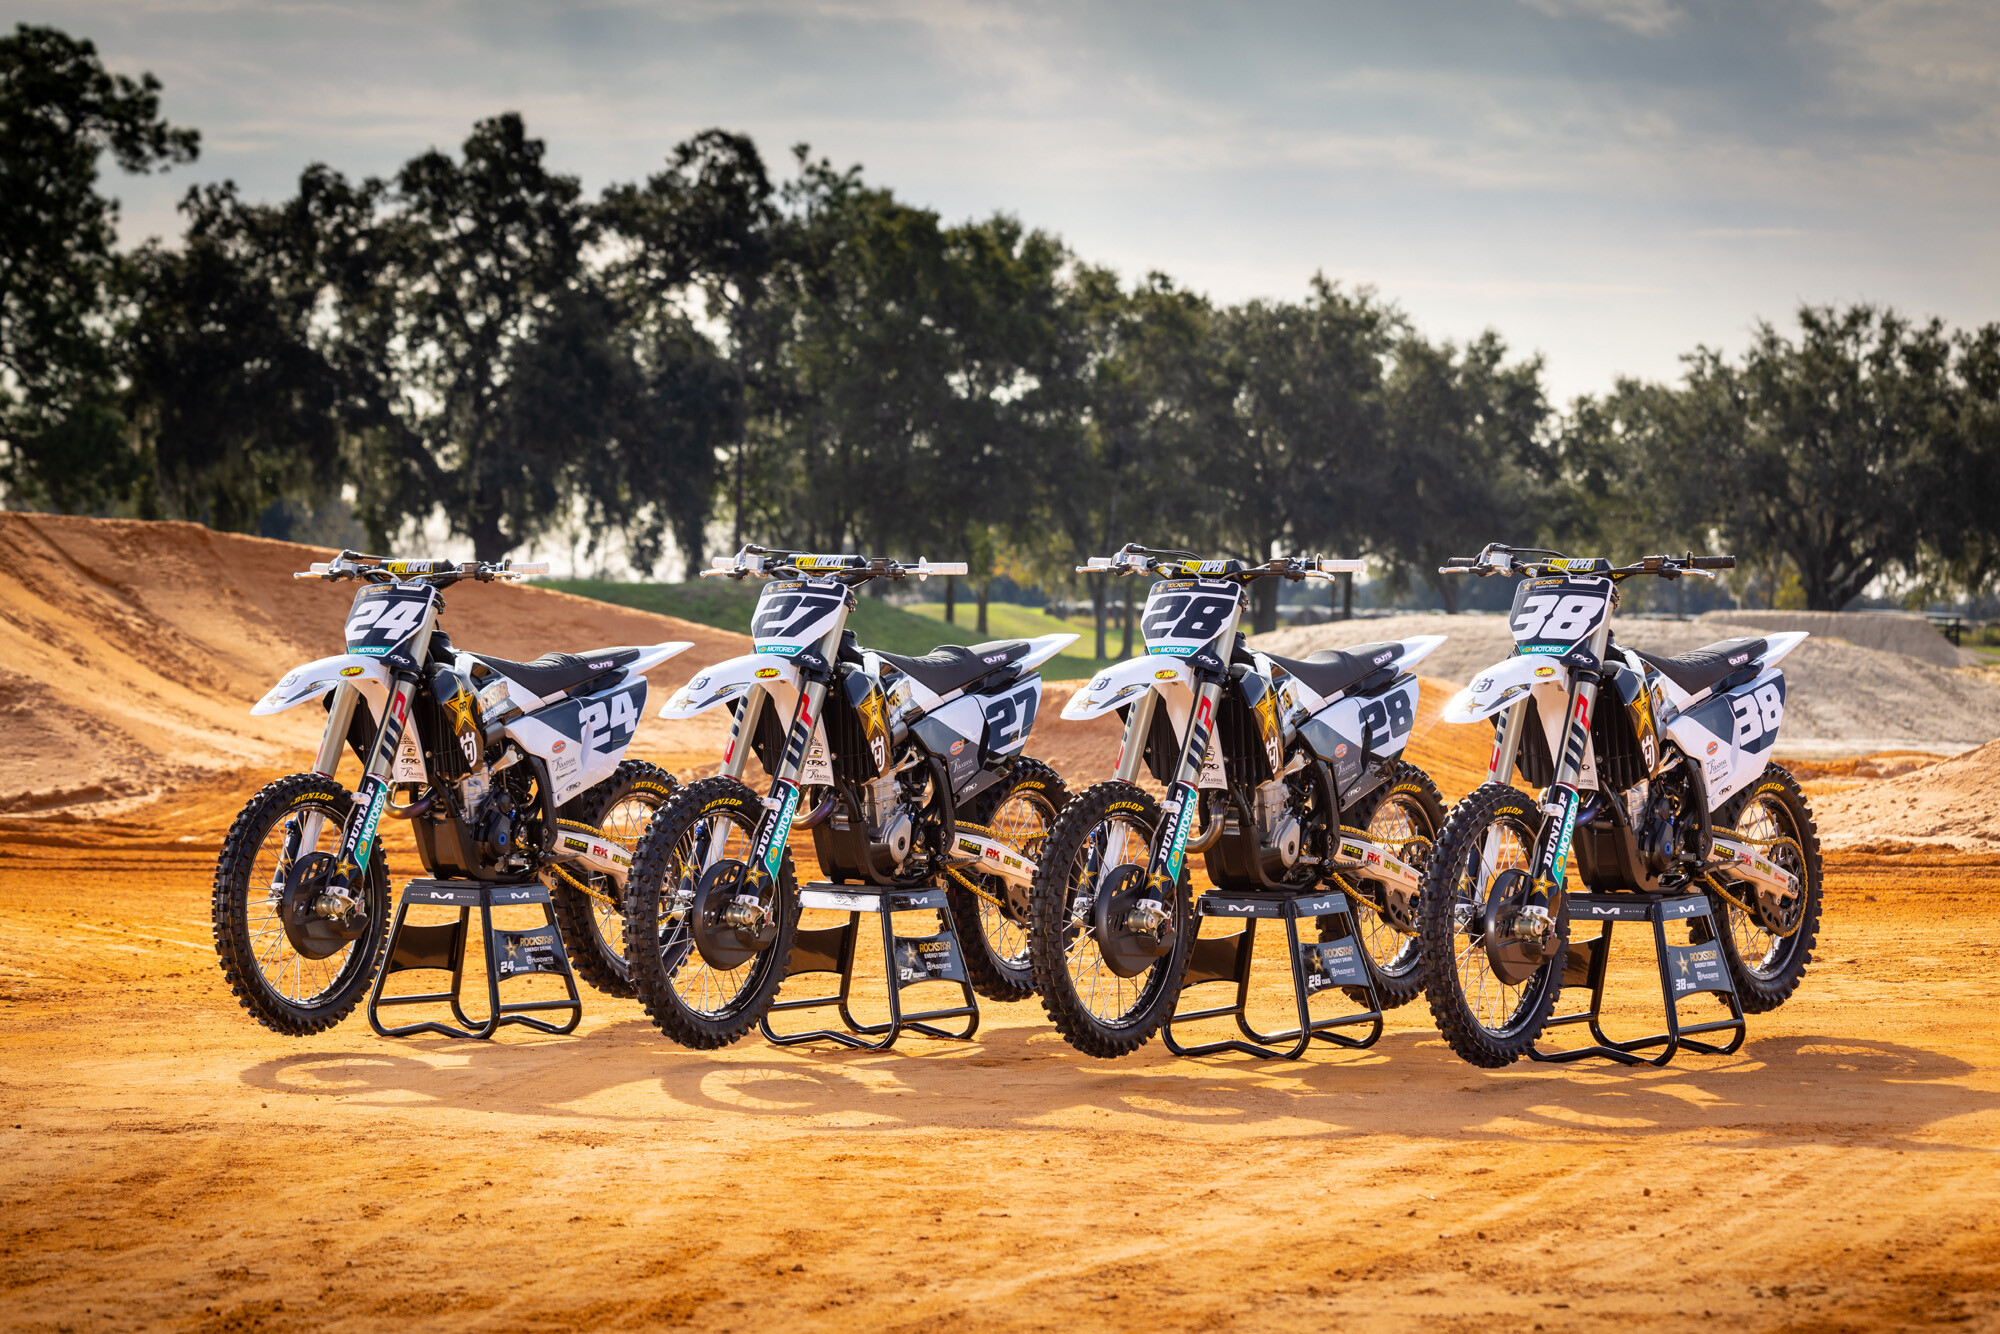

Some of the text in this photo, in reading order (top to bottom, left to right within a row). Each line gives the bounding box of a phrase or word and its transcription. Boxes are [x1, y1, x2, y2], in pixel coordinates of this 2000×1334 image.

[345, 601, 426, 641] 24
[753, 595, 841, 638] 27
[1142, 595, 1236, 640] 28
[1511, 595, 1605, 640] 38
[983, 654, 1008, 665] GUTS
[1373, 650, 1393, 665] GUTS
[1728, 654, 1749, 665] GUTS
[588, 660, 614, 670] GUTS
[341, 667, 364, 677] FMF
[755, 668, 780, 678] FMF
[1535, 667, 1556, 677] FMF
[578, 691, 639, 748] 24
[985, 686, 1038, 751] 27
[1358, 689, 1413, 750] 28
[1732, 683, 1783, 747] 38
[634, 781, 669, 795] DUNLOP
[1014, 781, 1046, 793] DUNLOP
[1393, 783, 1421, 794] DUNLOP
[1757, 782, 1785, 793] DUNLOP
[295, 792, 335, 802] DUNLOP
[704, 798, 743, 812] DUNLOP
[1109, 801, 1145, 812] DUNLOP
[362, 788, 386, 842] MOTOREX
[772, 793, 798, 848] MOTOREX
[1175, 796, 1197, 852] MOTOREX
[1558, 798, 1579, 856] MOTOREX
[960, 839, 981, 851] EXCEL
[1343, 844, 1362, 856] EXCEL
[1715, 844, 1734, 856] EXCEL
[593, 845, 609, 858] RK
[985, 848, 1000, 859] RK
[1367, 852, 1381, 864] RK
[520, 935, 554, 947] ROCKSTAR
[919, 941, 951, 953] ROCKSTAR
[1324, 946, 1354, 959] ROCKSTAR
[1689, 950, 1717, 963] ROCKSTAR
[500, 961, 515, 973] 24
[901, 968, 913, 980] 27
[1308, 974, 1321, 987] 28
[1675, 978, 1686, 991] 38
